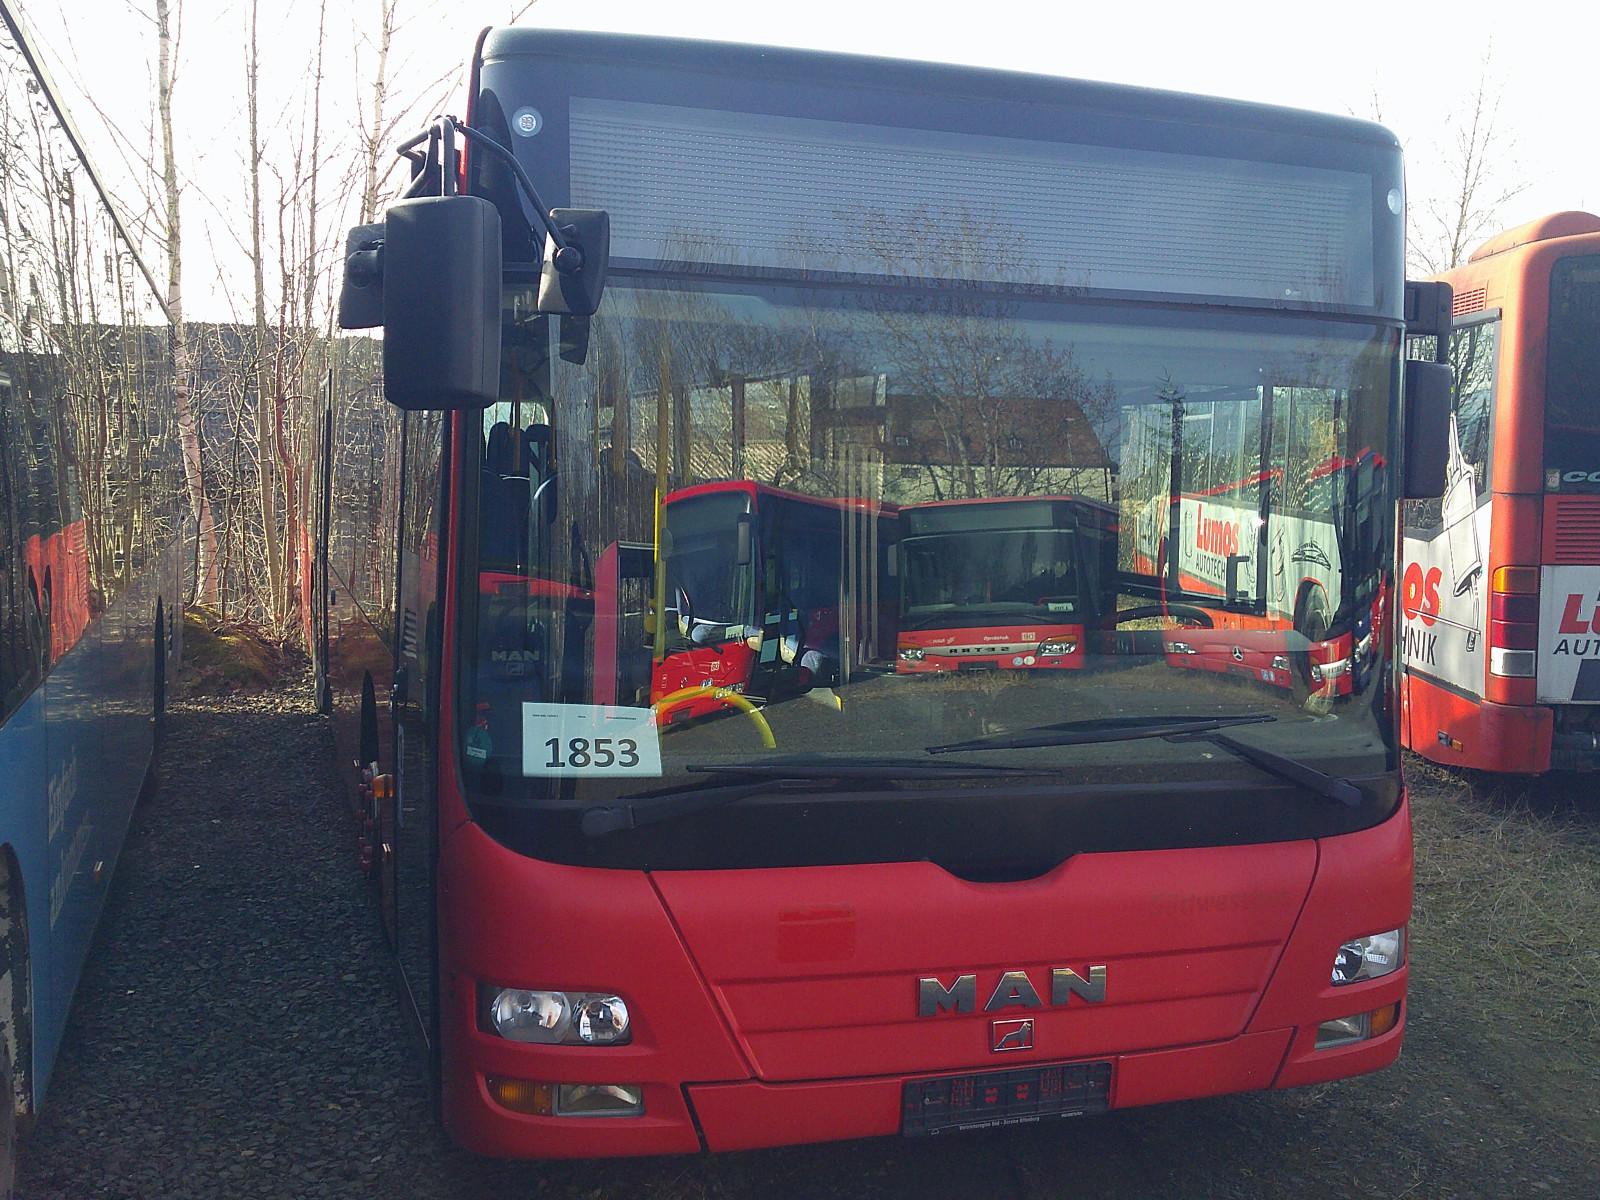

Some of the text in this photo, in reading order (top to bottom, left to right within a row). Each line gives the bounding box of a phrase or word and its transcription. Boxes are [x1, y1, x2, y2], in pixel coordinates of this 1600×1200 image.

[491, 650, 540, 661] MAN
[545, 737, 640, 768] 1853
[918, 964, 1107, 1016] MAN
